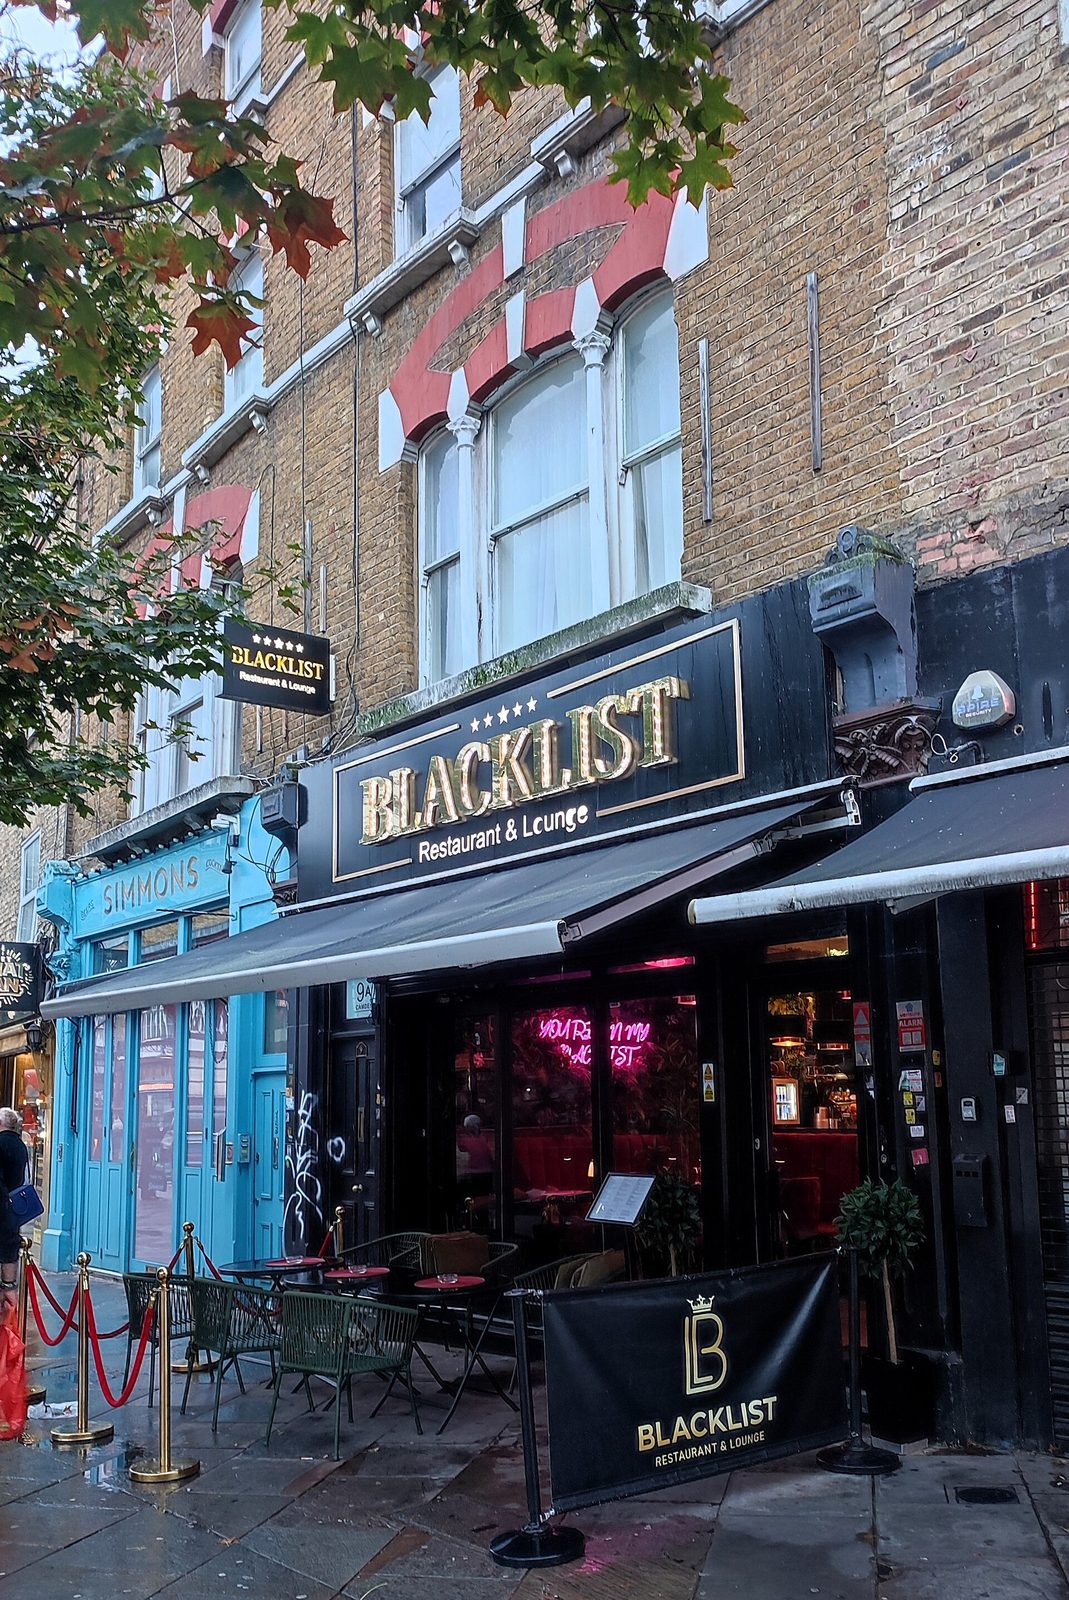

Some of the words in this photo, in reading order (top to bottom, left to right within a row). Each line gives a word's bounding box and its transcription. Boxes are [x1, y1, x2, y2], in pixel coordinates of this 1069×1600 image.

[231, 645, 324, 680] BLACKLIST
[239, 671, 281, 687] Restaurant
[281, 679, 288, 689] &
[288, 680, 316, 695] Lounge
[965, 707, 992, 718] SECURITY
[359, 676, 689, 845] BLACKLIST
[418, 824, 501, 864] Restaurant
[505, 818, 518, 839] &
[522, 804, 589, 838] Lounge
[103, 855, 199, 915] SIMMONS
[625, 1022, 650, 1043] MY
[637, 1396, 777, 1452] BLACKLIST
[655, 1442, 718, 1468] RESTAURANT
[720, 1442, 728, 1451] &
[729, 1431, 765, 1449] LOUNGE
